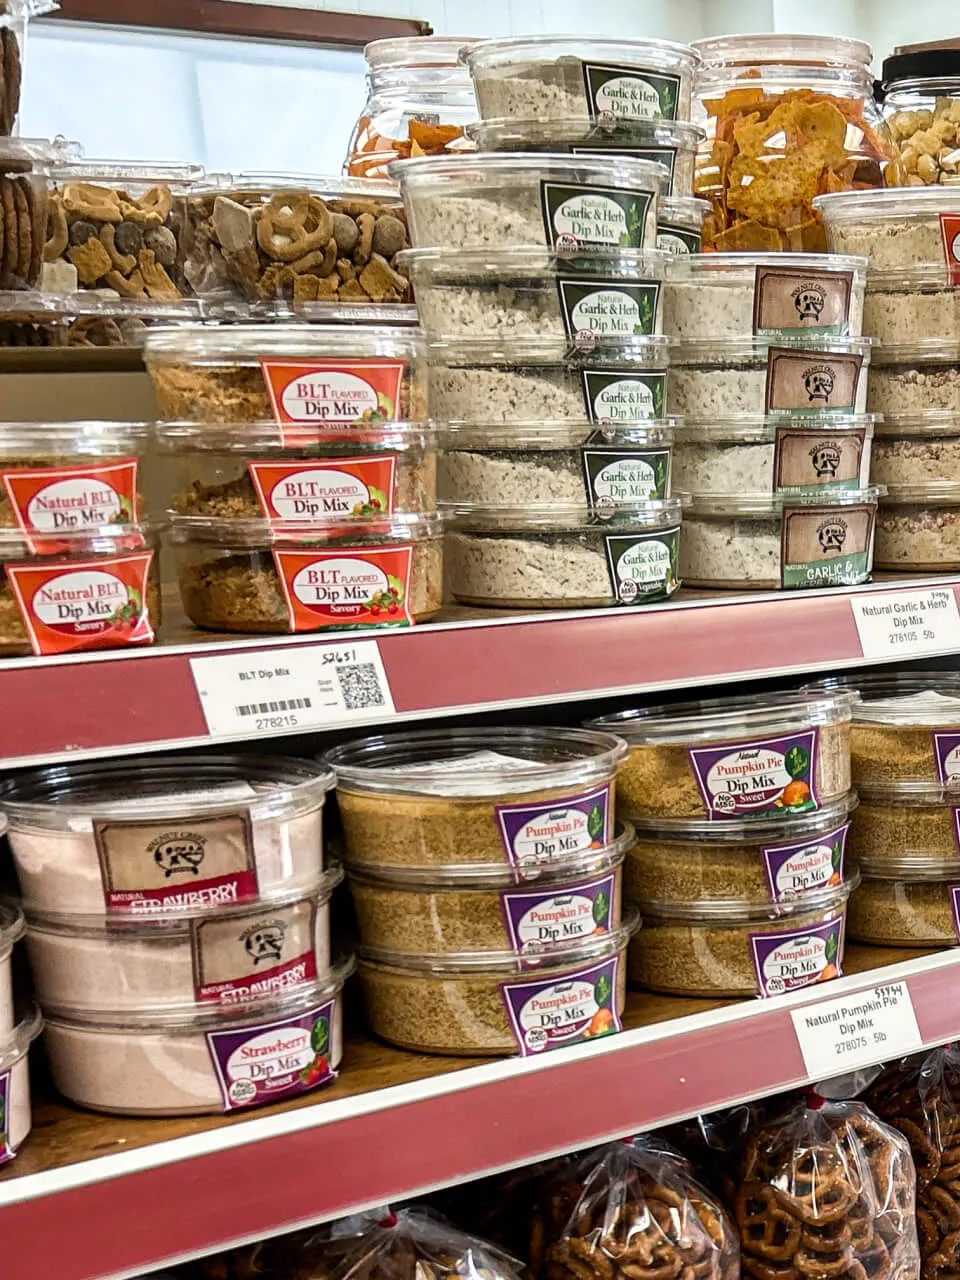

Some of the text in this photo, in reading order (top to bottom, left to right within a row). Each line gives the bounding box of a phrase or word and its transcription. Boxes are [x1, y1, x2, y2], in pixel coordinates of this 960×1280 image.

[561, 206, 624, 223] Garlic & Herb
[572, 221, 614, 238] Dip Mix
[296, 382, 368, 399] BLT FLAVORED
[304, 401, 359, 417] Dip Mix
[601, 472, 628, 483] Garlic
[629, 472, 636, 481] &
[610, 485, 645, 498] Dip Mix
[307, 569, 378, 584] BLT FLAVORED
[807, 565, 842, 580] GARLIC
[41, 581, 120, 603] Natural BLT
[316, 585, 369, 602] Dip Mix
[57, 601, 112, 620] Dip Mix
[330, 603, 360, 613] Savory
[862, 600, 947, 616] Natural Garlic & Herb
[893, 616, 924, 627] Dip Mix
[239, 667, 290, 681] BLT Dip Mix
[256, 715, 297, 729] 278215
[717, 757, 782, 776] Pumpkin Pie
[727, 775, 775, 794] Dip Mix
[718, 794, 731, 802] No
[525, 822, 571, 838] Pumpkin
[534, 837, 578, 856] Dip Mix
[130, 881, 237, 913] STRAWBERRY
[805, 996, 897, 1028] Natural Pumpkin Pie
[840, 1019, 874, 1035] Dip Mix
[240, 1037, 307, 1059] Strawberry
[835, 1032, 886, 1054] 278075 5lb
[249, 1058, 300, 1080] Dip Mix
